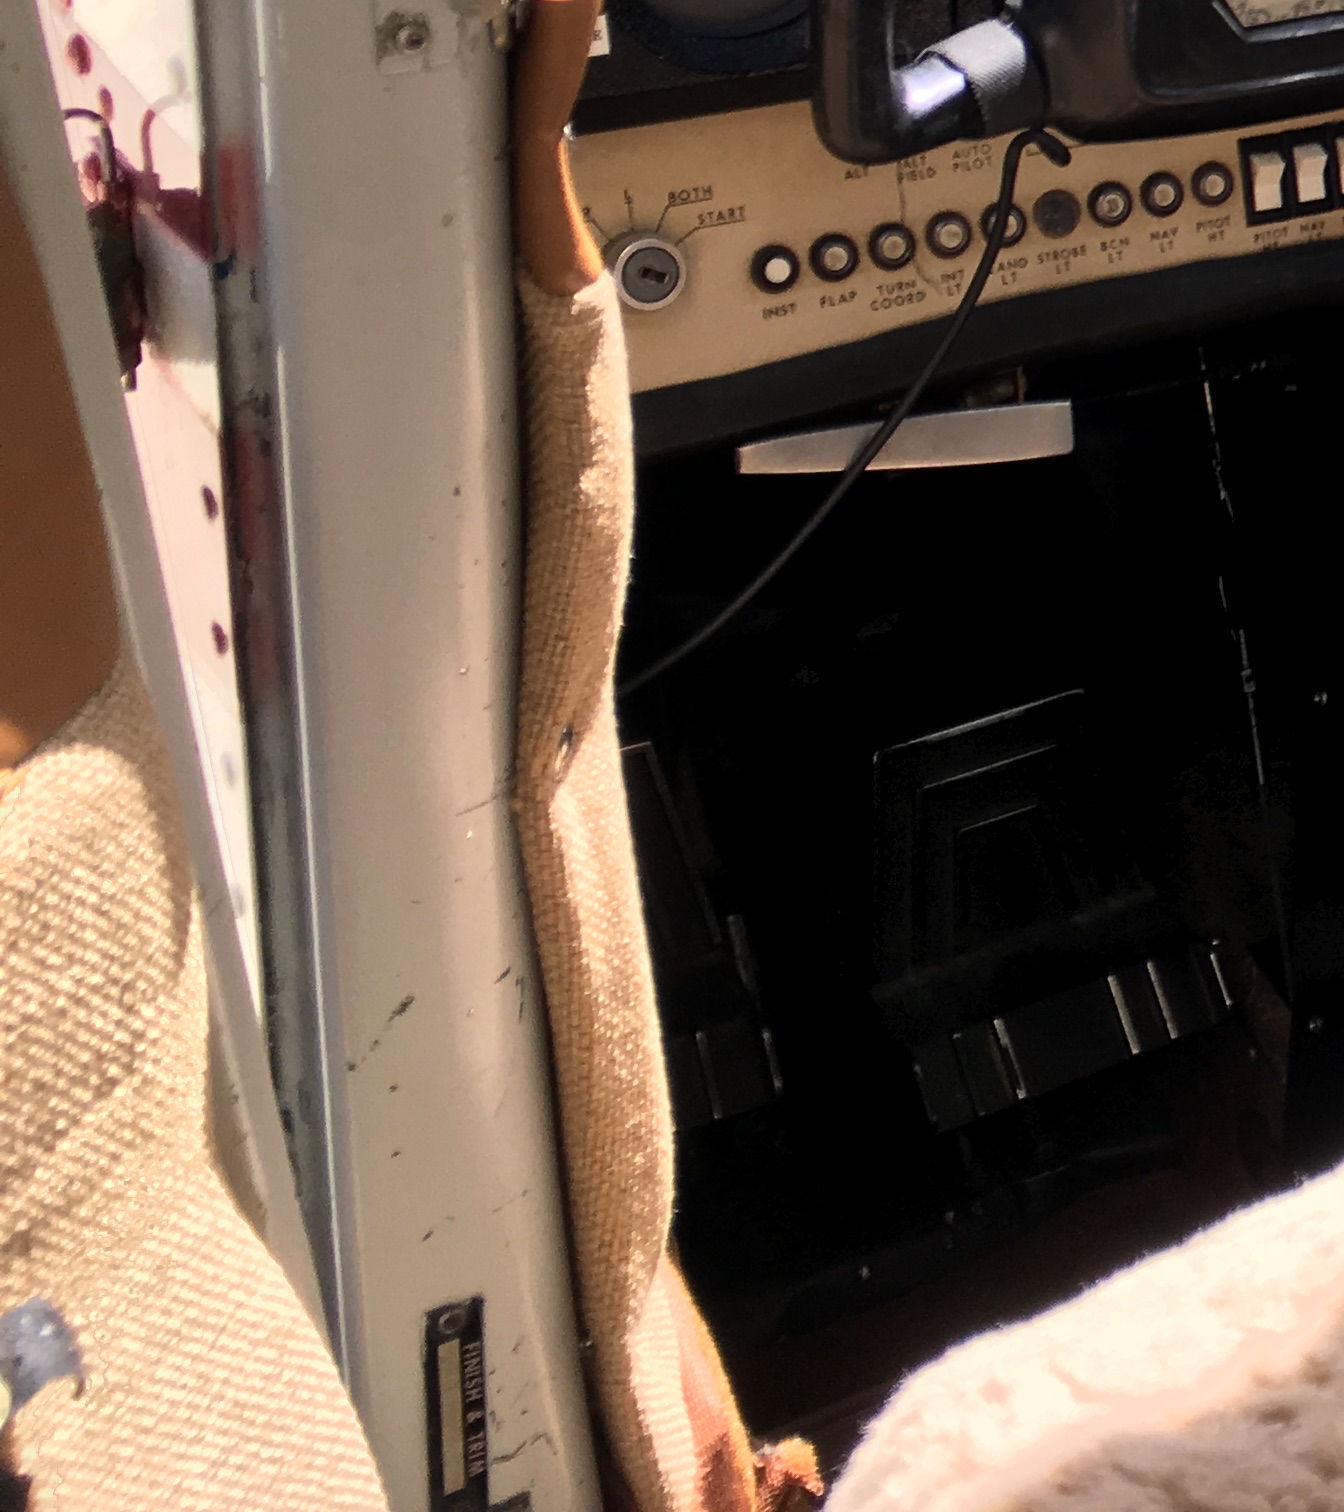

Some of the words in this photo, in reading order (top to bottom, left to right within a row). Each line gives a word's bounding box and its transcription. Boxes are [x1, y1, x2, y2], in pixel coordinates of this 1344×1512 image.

[952, 143, 992, 160] AUTO
[952, 155, 993, 173] PILOT
[898, 166, 937, 184] FIELD
[667, 185, 713, 204] BOTH
[697, 205, 747, 226] START
[1196, 215, 1232, 232] PITOT
[1150, 226, 1179, 242] NAV
[995, 256, 1029, 272] AND
[1037, 245, 1088, 265] STROBE
[876, 279, 917, 295] TURN
[819, 291, 858, 309] FLAP
[870, 291, 927, 311] COORD
[762, 302, 797, 320] INST
[462, 1341, 484, 1404] FINISH
[467, 1410, 484, 1425] &
[467, 1430, 487, 1479] TRIM
